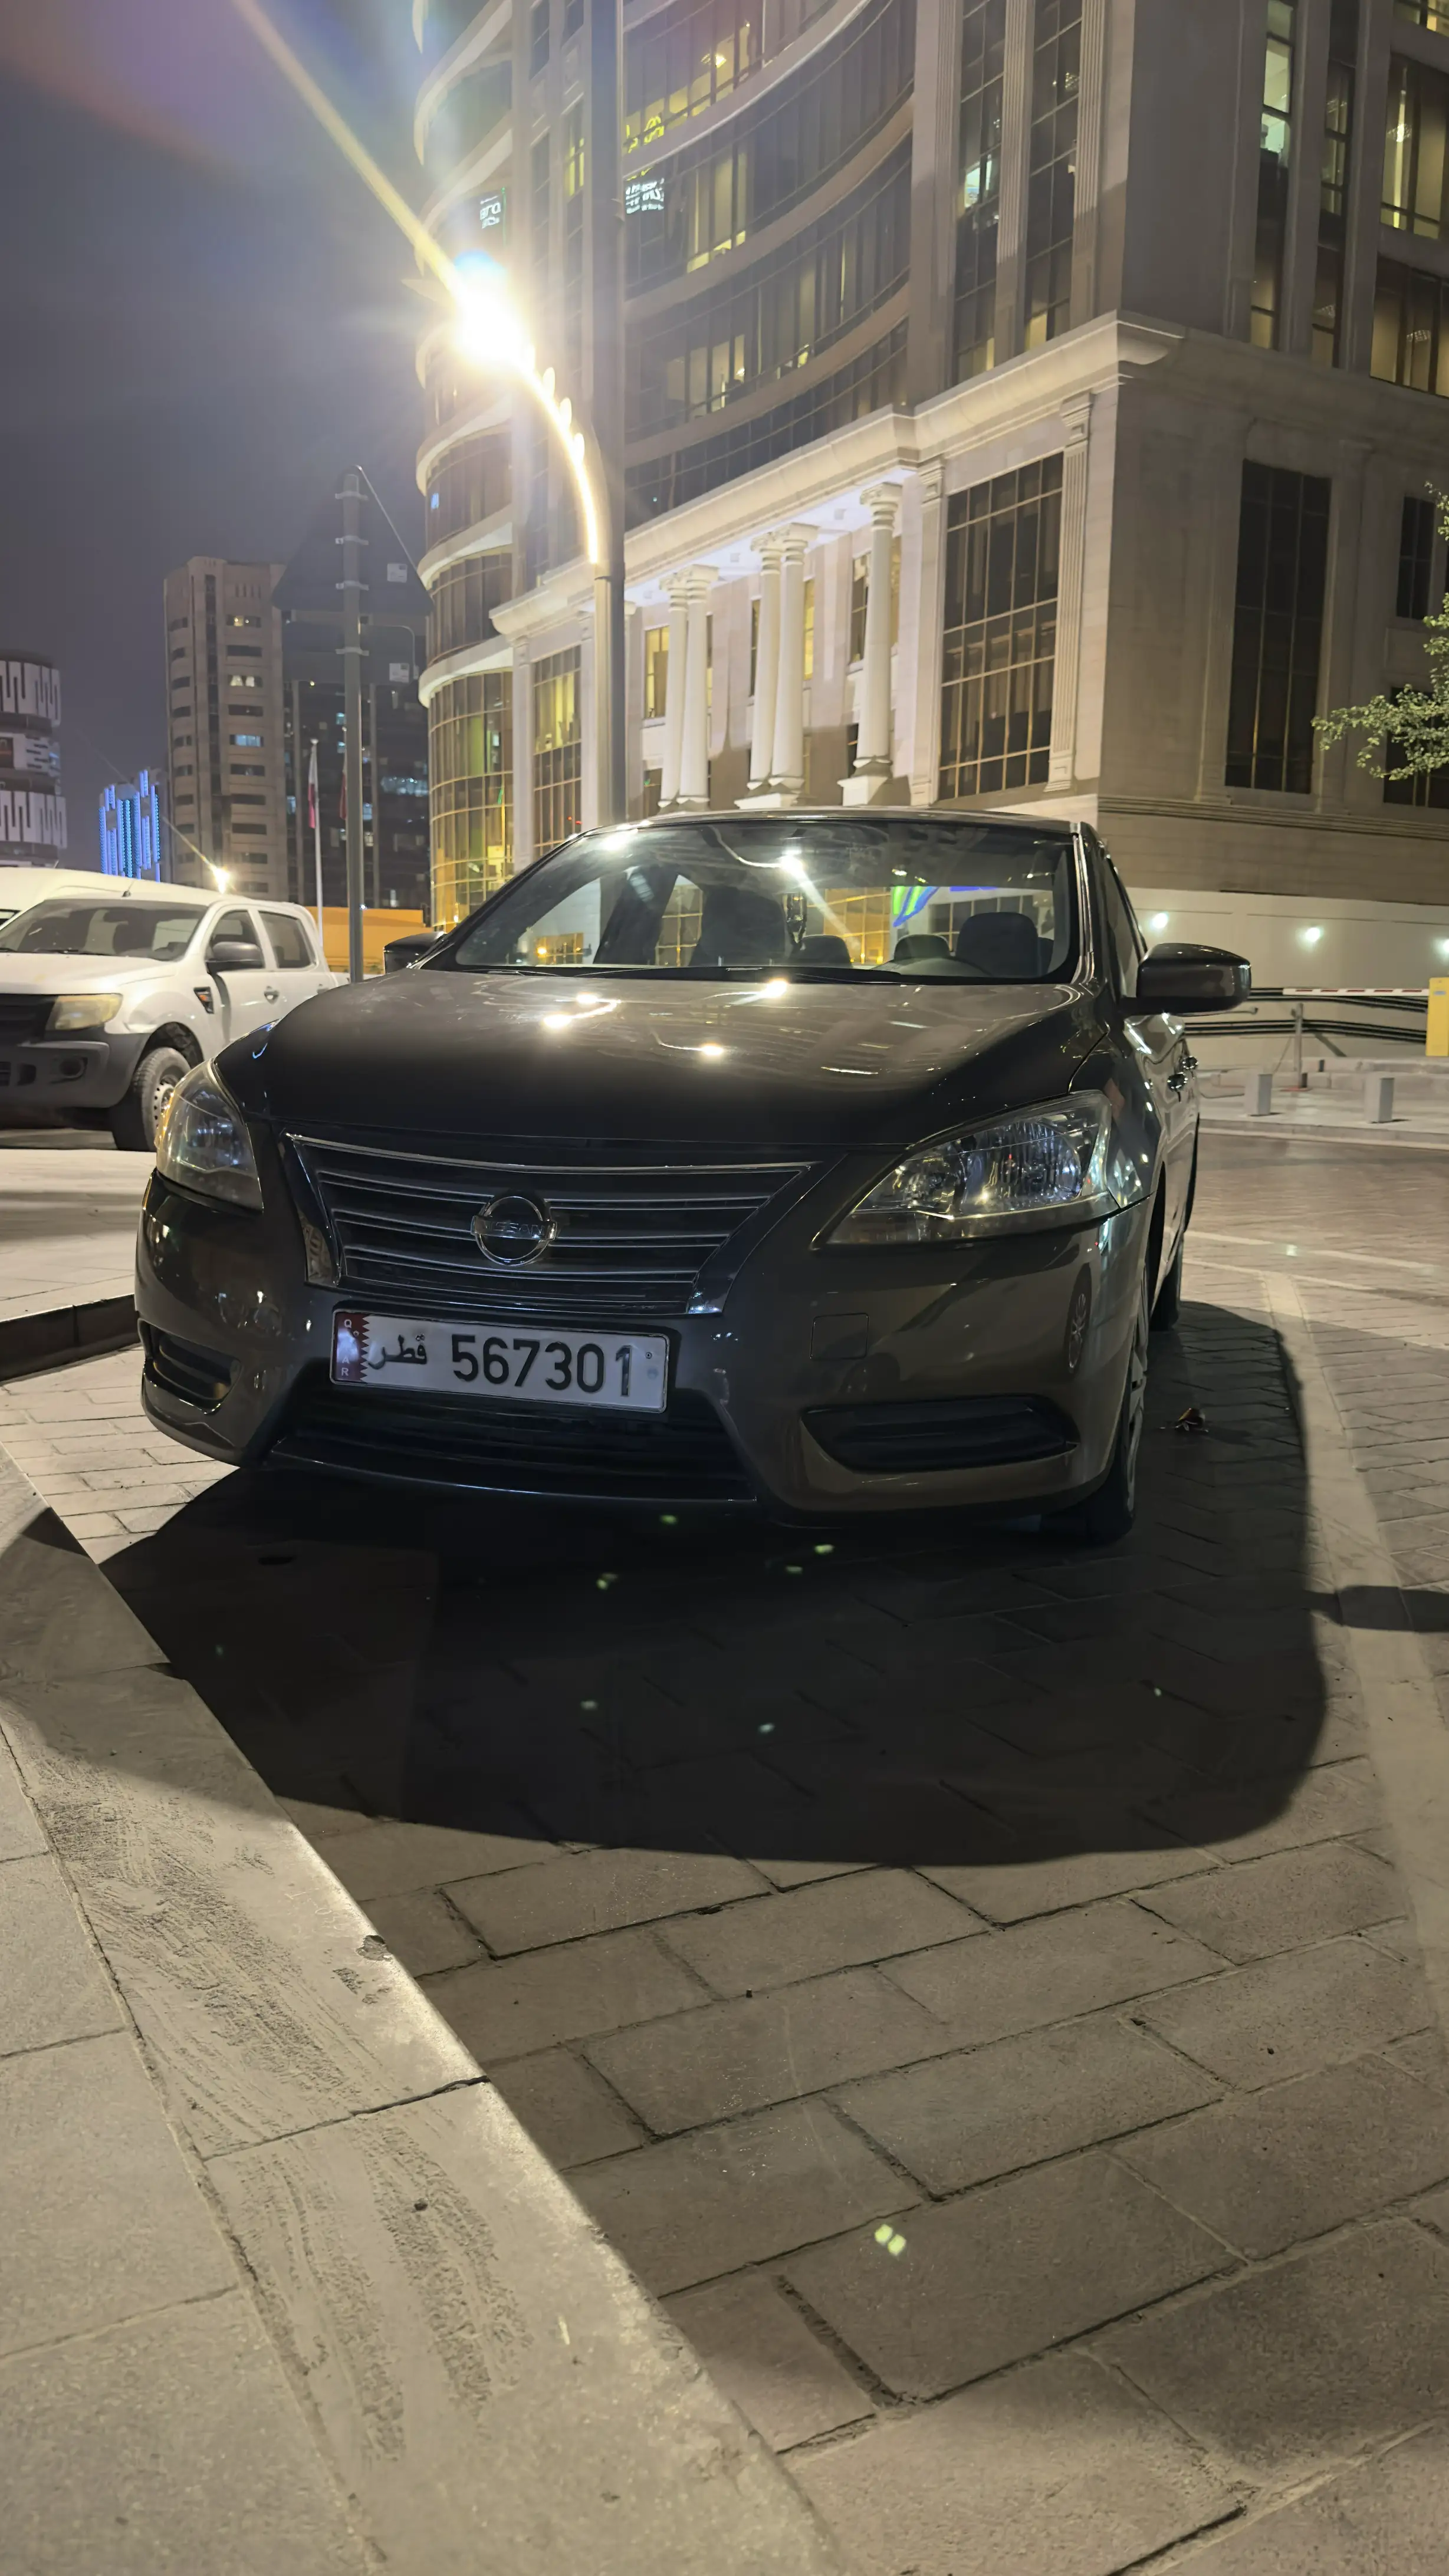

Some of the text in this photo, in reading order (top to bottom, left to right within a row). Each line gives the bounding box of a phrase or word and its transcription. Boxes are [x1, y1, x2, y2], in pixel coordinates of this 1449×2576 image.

[341, 1318, 353, 1377] QAR
[367, 1333, 428, 1370] قطر
[451, 1334, 632, 1397] 567301
